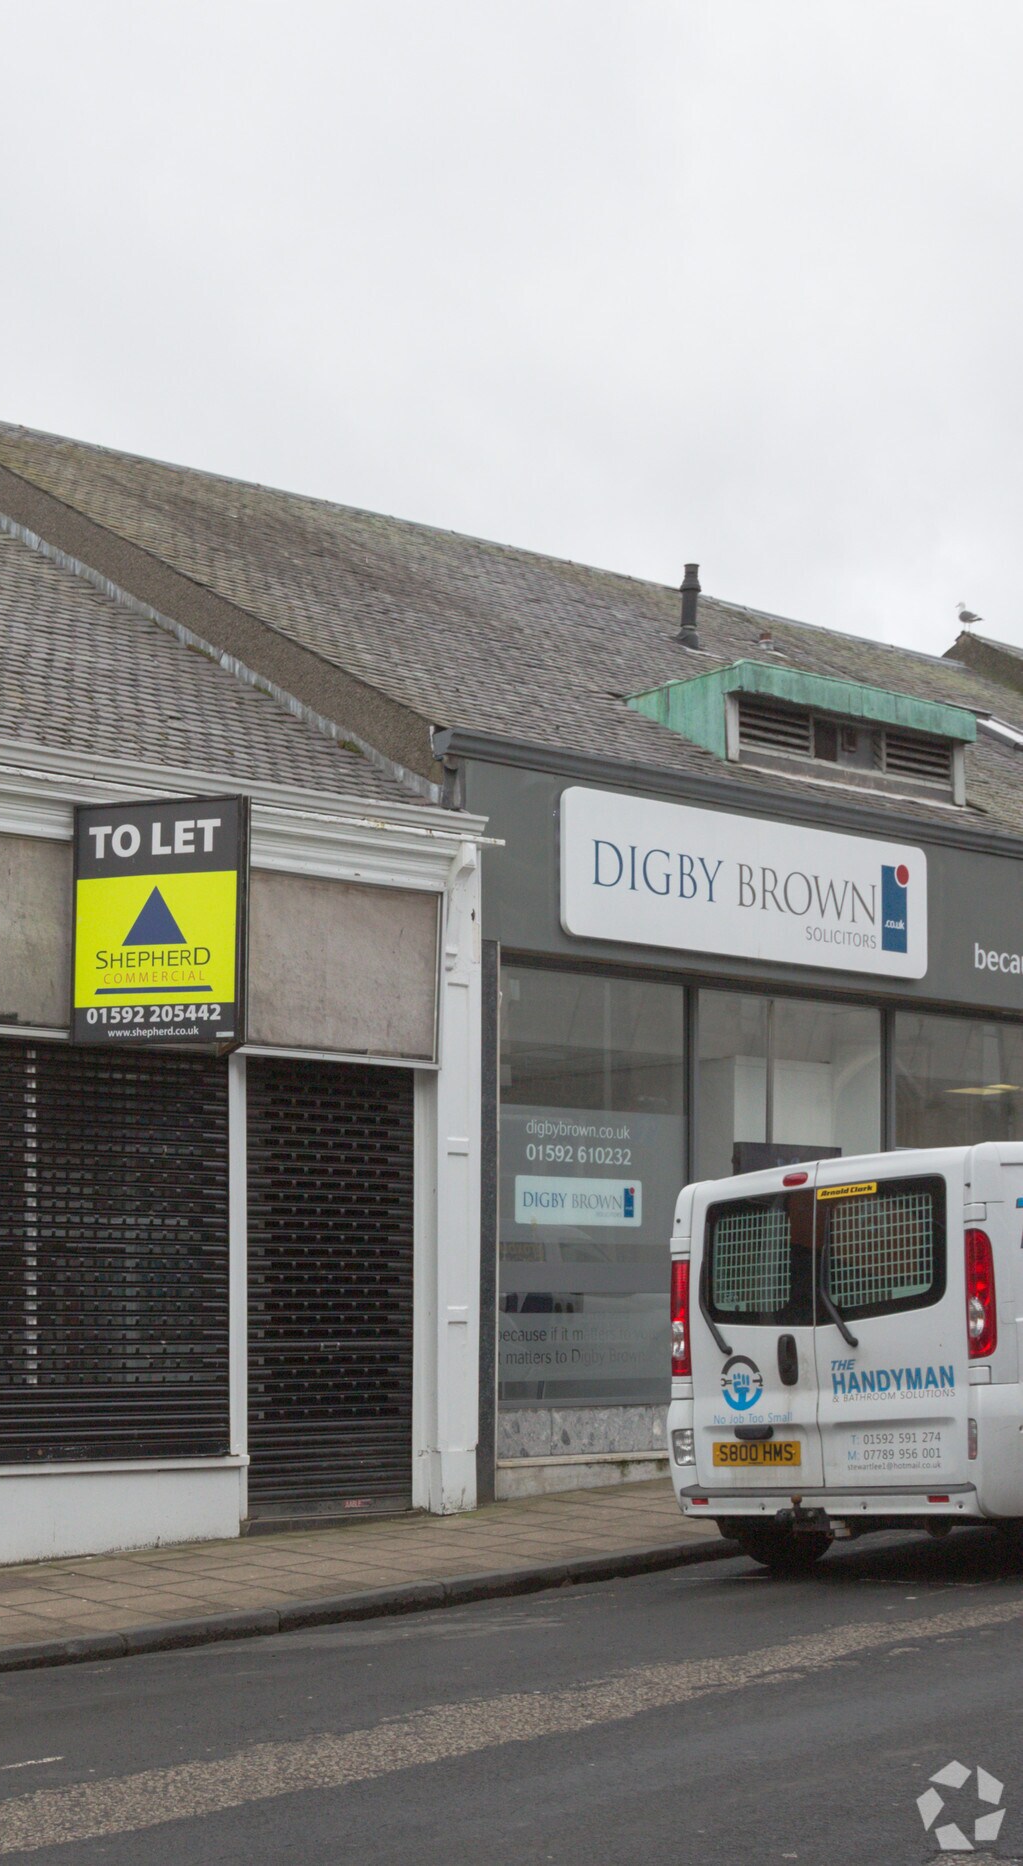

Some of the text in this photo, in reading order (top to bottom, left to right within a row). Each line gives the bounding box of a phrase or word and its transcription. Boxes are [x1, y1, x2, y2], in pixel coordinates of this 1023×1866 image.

[88, 818, 221, 859] TO LET
[591, 838, 877, 926] DIGBY BROWN
[805, 926, 877, 950] SOLICITORS
[95, 947, 211, 970] SHEPHERD
[974, 942, 1023, 975] beca
[103, 970, 206, 985] COMMERCIAL
[86, 1004, 222, 1025] 01592 205442
[107, 1025, 200, 1039] www.shepherd.co.uk
[526, 1119, 631, 1140] digbybrown.co.uk
[526, 1144, 632, 1166] 01592 610232
[522, 1191, 623, 1210] DIGBY BROWN
[821, 1185, 873, 1197] Arnold Clark
[505, 1351, 552, 1365] matters
[554, 1350, 568, 1364] to
[831, 1359, 855, 1371] THE
[831, 1365, 955, 1395] HANDYMAN
[843, 1392, 896, 1403] BATHROOM
[900, 1389, 956, 1400] SOLUTIONS
[713, 1411, 793, 1425] No Job Too Small
[863, 1433, 894, 1445] 01592
[898, 1432, 917, 1444] 591
[921, 1431, 941, 1443] 274
[719, 1443, 794, 1462] S800 HMS
[863, 1449, 894, 1460] 07789
[898, 1448, 918, 1460] 956
[921, 1447, 942, 1459] 001
